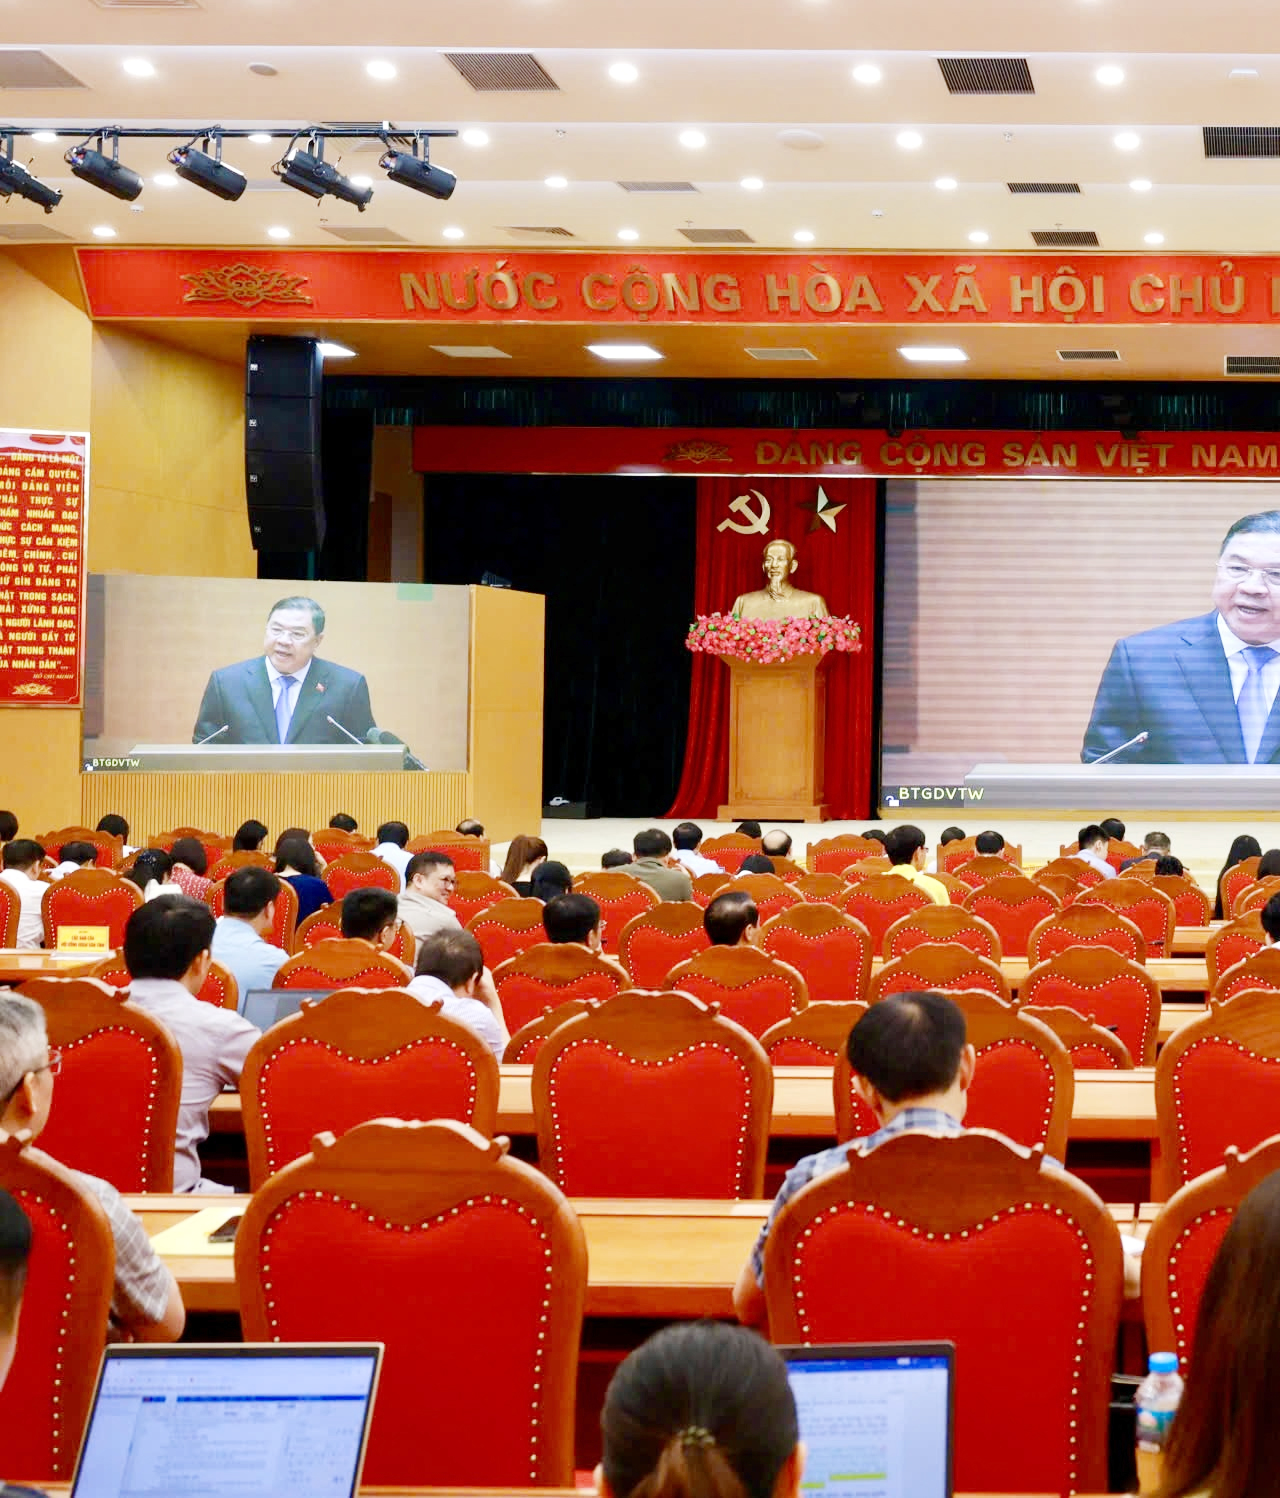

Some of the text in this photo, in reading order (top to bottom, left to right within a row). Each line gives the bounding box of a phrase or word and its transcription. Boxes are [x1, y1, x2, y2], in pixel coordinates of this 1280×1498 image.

[400, 260, 559, 311] NƯỚC
[581, 264, 741, 321] CỘNG
[766, 261, 883, 313] HÒA
[905, 265, 990, 314] XÃ
[1009, 266, 1105, 323] HỘI
[1130, 260, 1245, 315] CHỦ
[880, 434, 986, 473] CỘNG
[1002, 432, 1078, 467] SẢN
[1095, 436, 1174, 474] VIỆT
[1191, 444, 1279, 468] NAM
[0, 492, 17, 504] HẢI
[0, 520, 12, 531] ỨC
[0, 535, 16, 546] HỰC
[0, 561, 18, 572] ÔNG
[66, 579, 76, 587] TA
[19, 592, 46, 601] TRONG
[0, 601, 14, 613] HẢI
[17, 646, 44, 655] TRUNG
[93, 758, 139, 767] BTGDVTW
[899, 787, 984, 800] BTGDVTW
